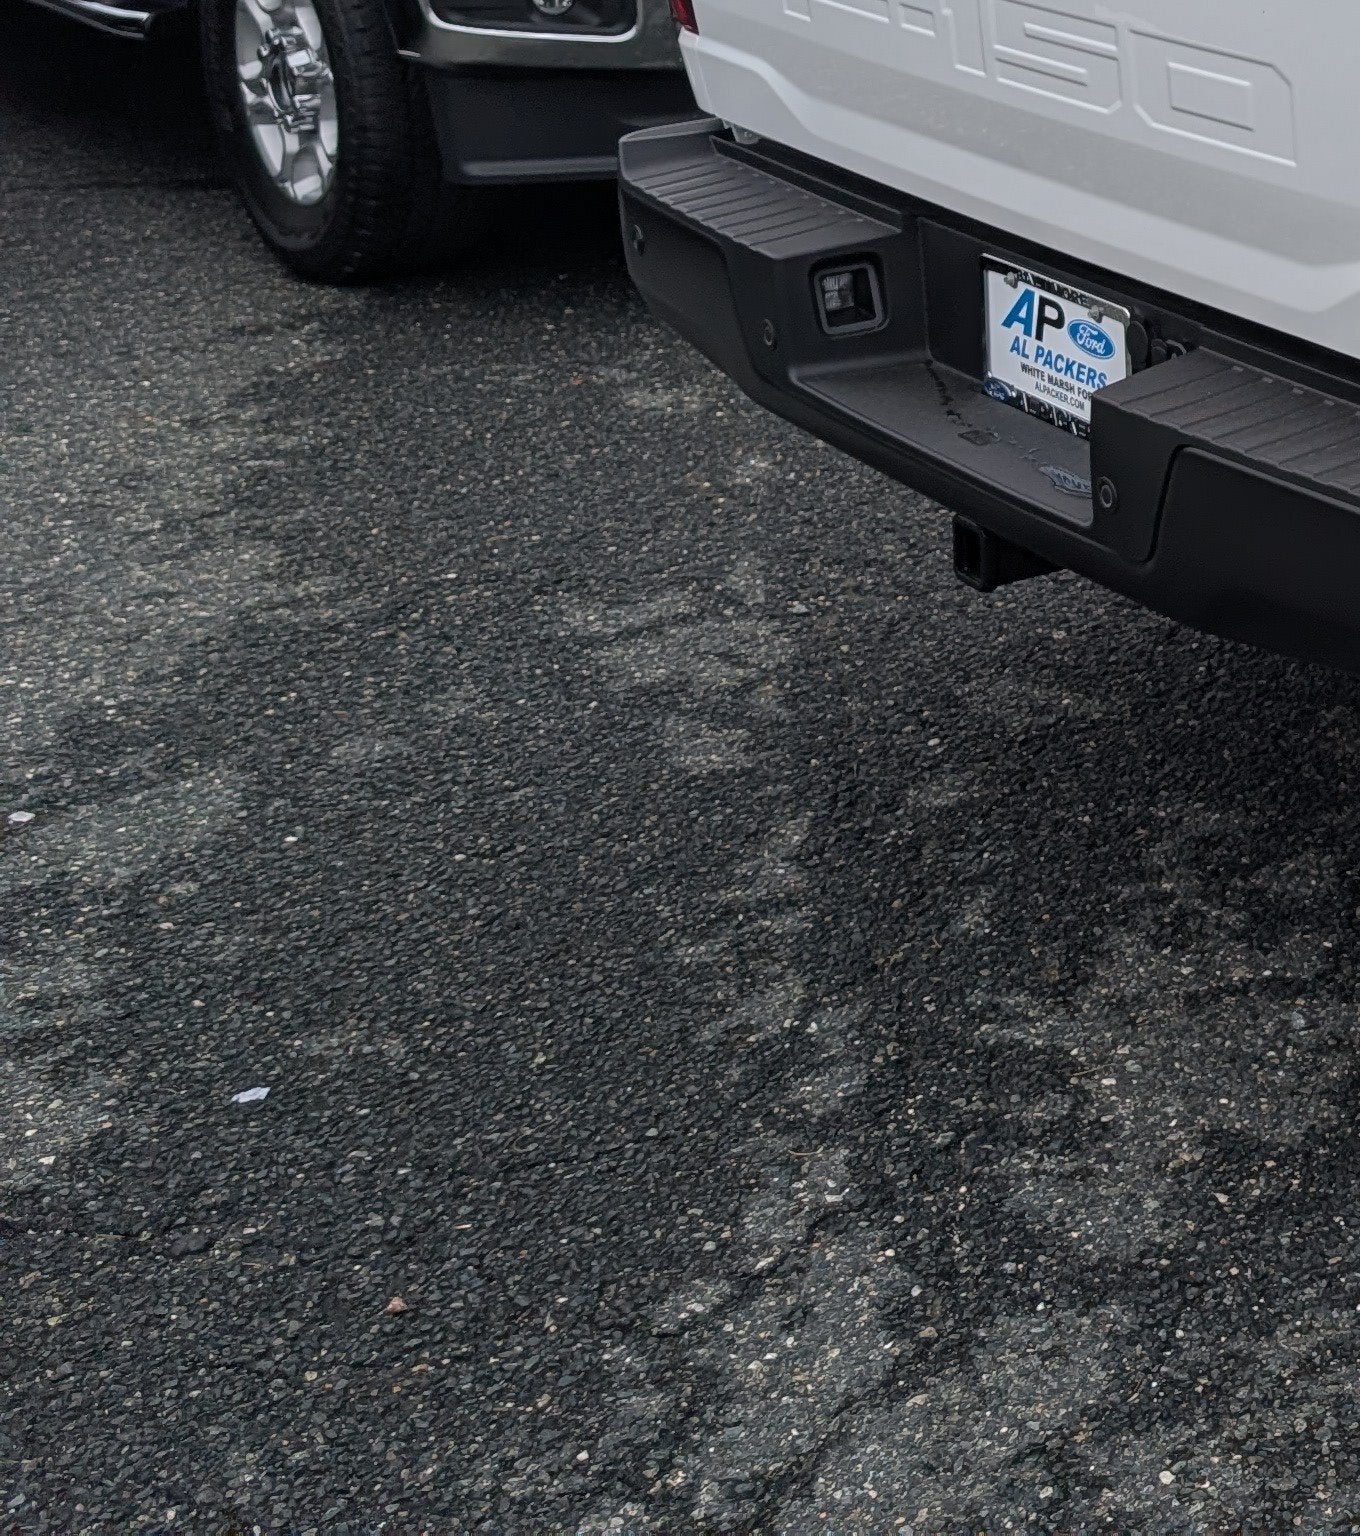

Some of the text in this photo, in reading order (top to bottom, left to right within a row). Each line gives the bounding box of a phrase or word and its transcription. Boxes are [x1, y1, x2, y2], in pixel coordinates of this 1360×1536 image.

[1001, 288, 1066, 342] AP
[1075, 323, 1106, 354] Ford
[1009, 336, 1108, 390] AL PACKERS
[1020, 362, 1093, 402] WHITE MARSH FOR
[1034, 381, 1085, 411] ALPACKER.COM
